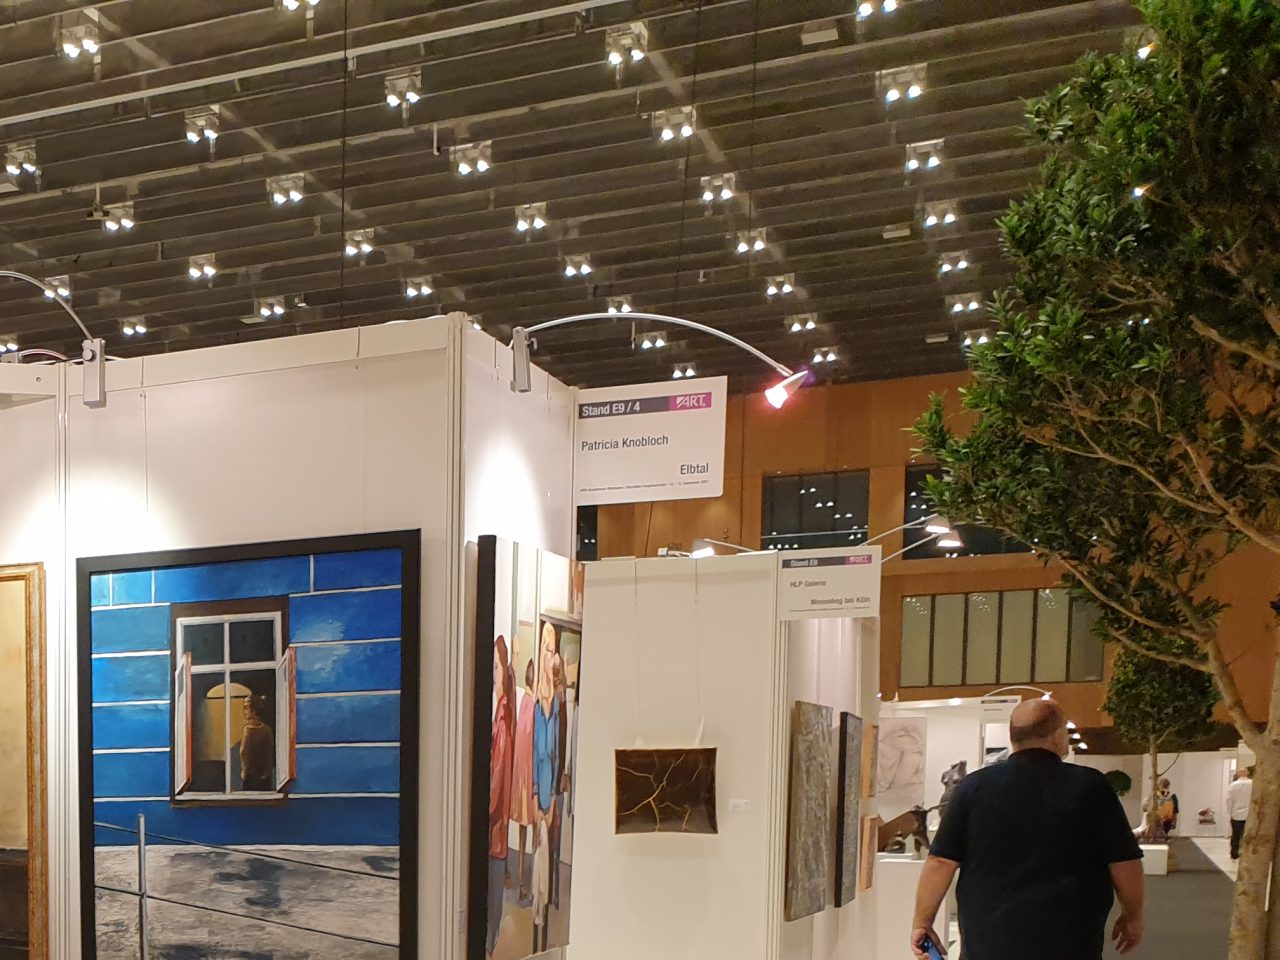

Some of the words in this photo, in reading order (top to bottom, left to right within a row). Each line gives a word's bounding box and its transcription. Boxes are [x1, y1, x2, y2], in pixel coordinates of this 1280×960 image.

[582, 404, 609, 417] Stand
[612, 402, 625, 414] E9
[626, 402, 631, 413] /
[633, 401, 640, 412] 4
[581, 439, 619, 451] Patricia
[622, 435, 669, 448] Knobloch
[680, 463, 709, 475] Elbtal
